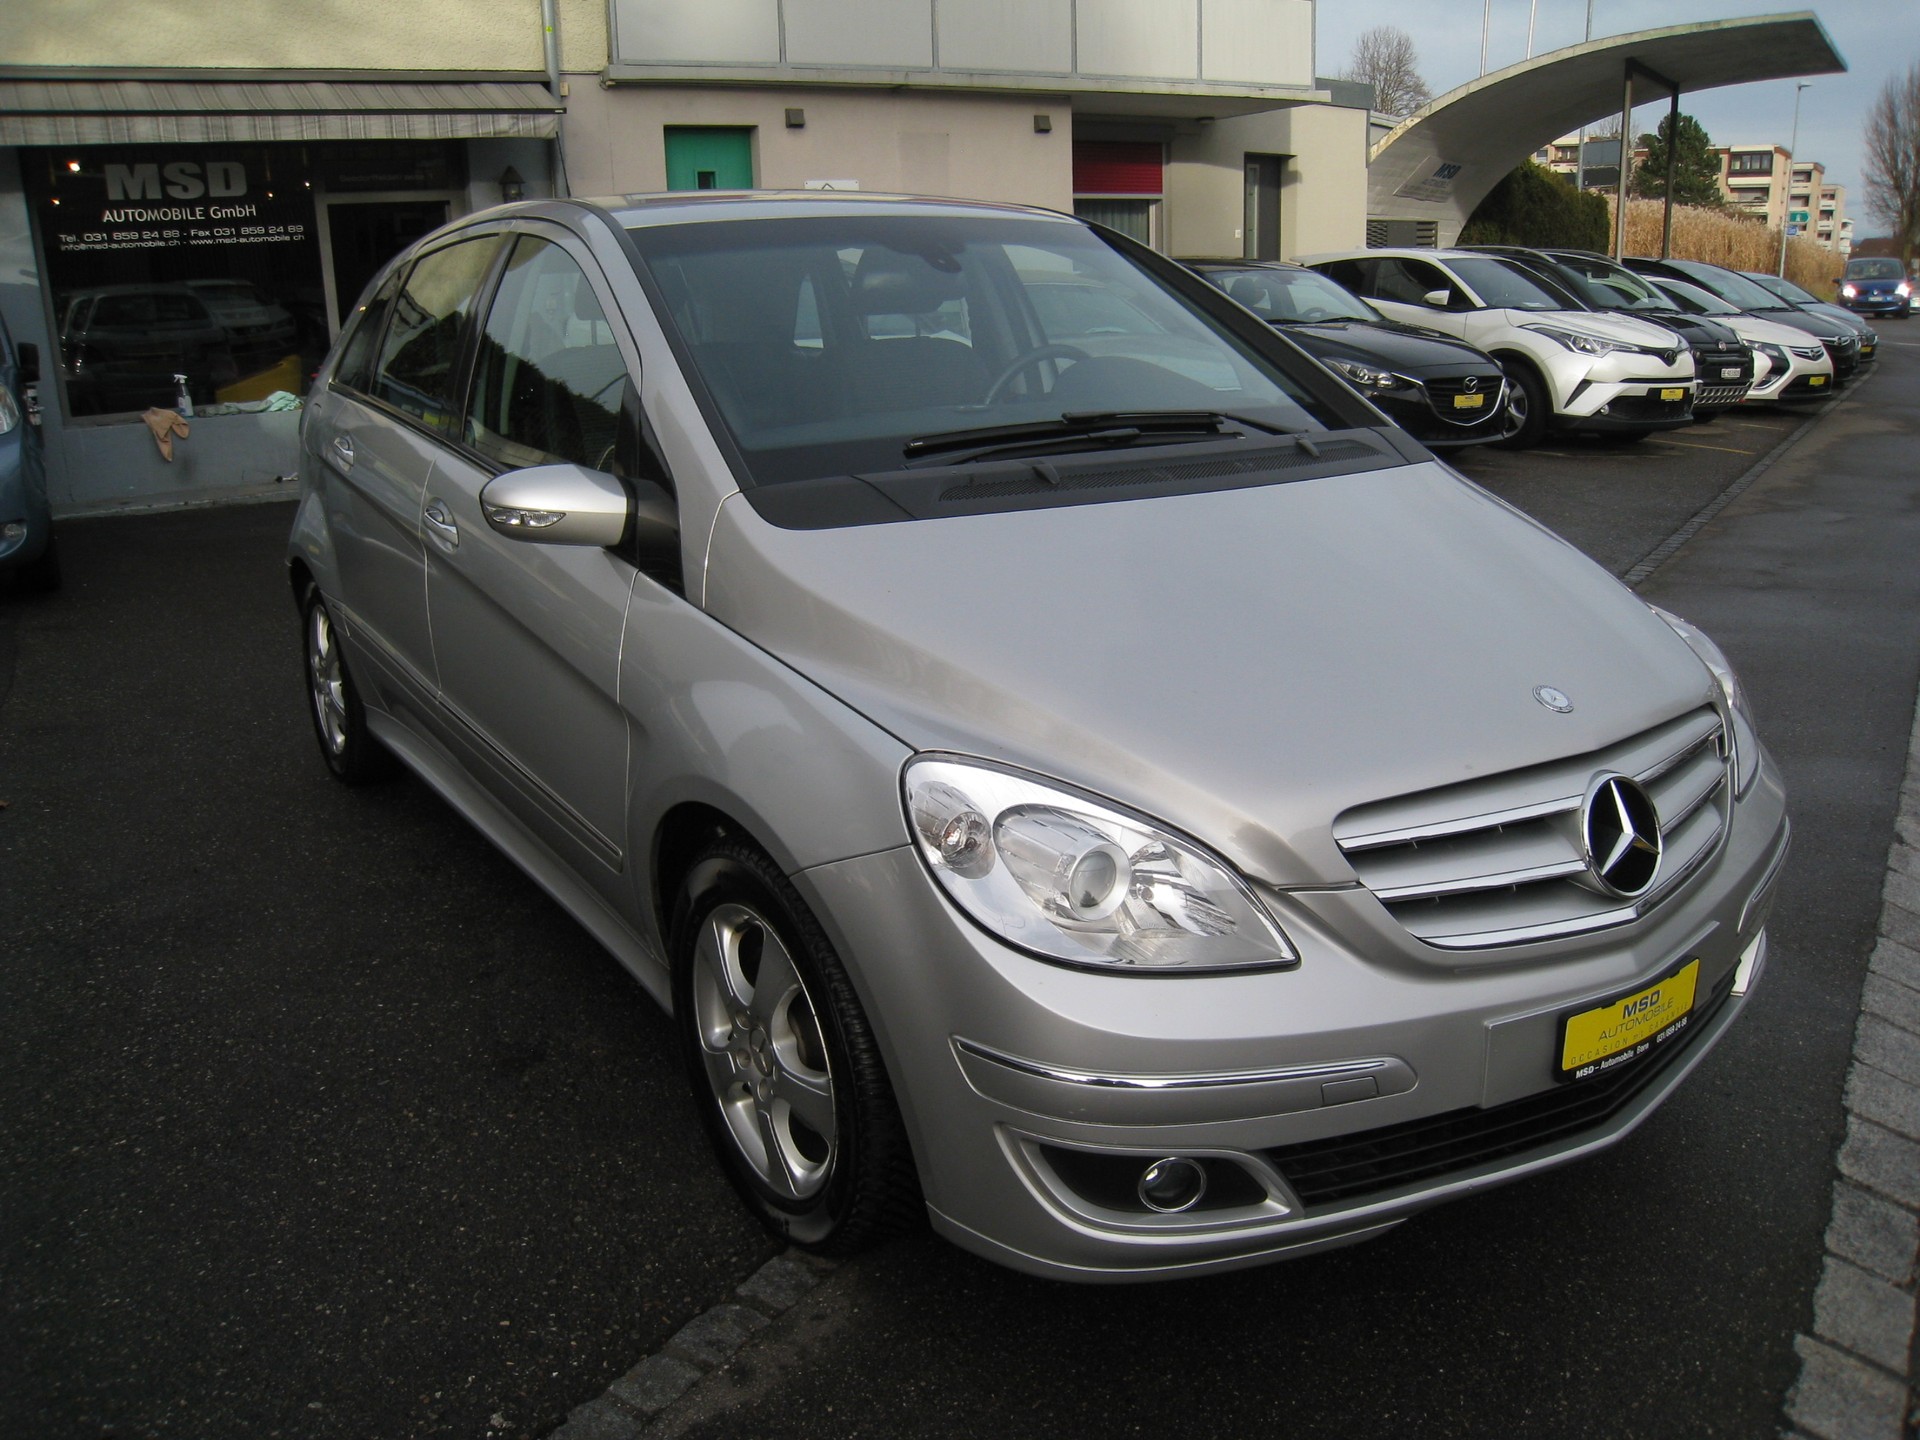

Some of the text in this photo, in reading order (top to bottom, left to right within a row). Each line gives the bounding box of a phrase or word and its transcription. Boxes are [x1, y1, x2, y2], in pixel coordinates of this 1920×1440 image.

[104, 162, 247, 200] MSD
[103, 205, 257, 222] AUTOMOBILE GmbH
[59, 234, 80, 243] Tel.
[84, 233, 107, 242] 031
[113, 232, 139, 240] 859
[142, 231, 159, 239] 24
[163, 230, 180, 238] 88
[191, 229, 211, 237] Fax
[214, 228, 236, 236] 031
[241, 226, 265, 235] 859
[268, 226, 284, 234] 24
[288, 225, 304, 233] 89
[1598, 997, 1674, 1042] AUTOMOBILE
[1622, 990, 1661, 1020] MSD
[1570, 1037, 1628, 1066] OCCASION
